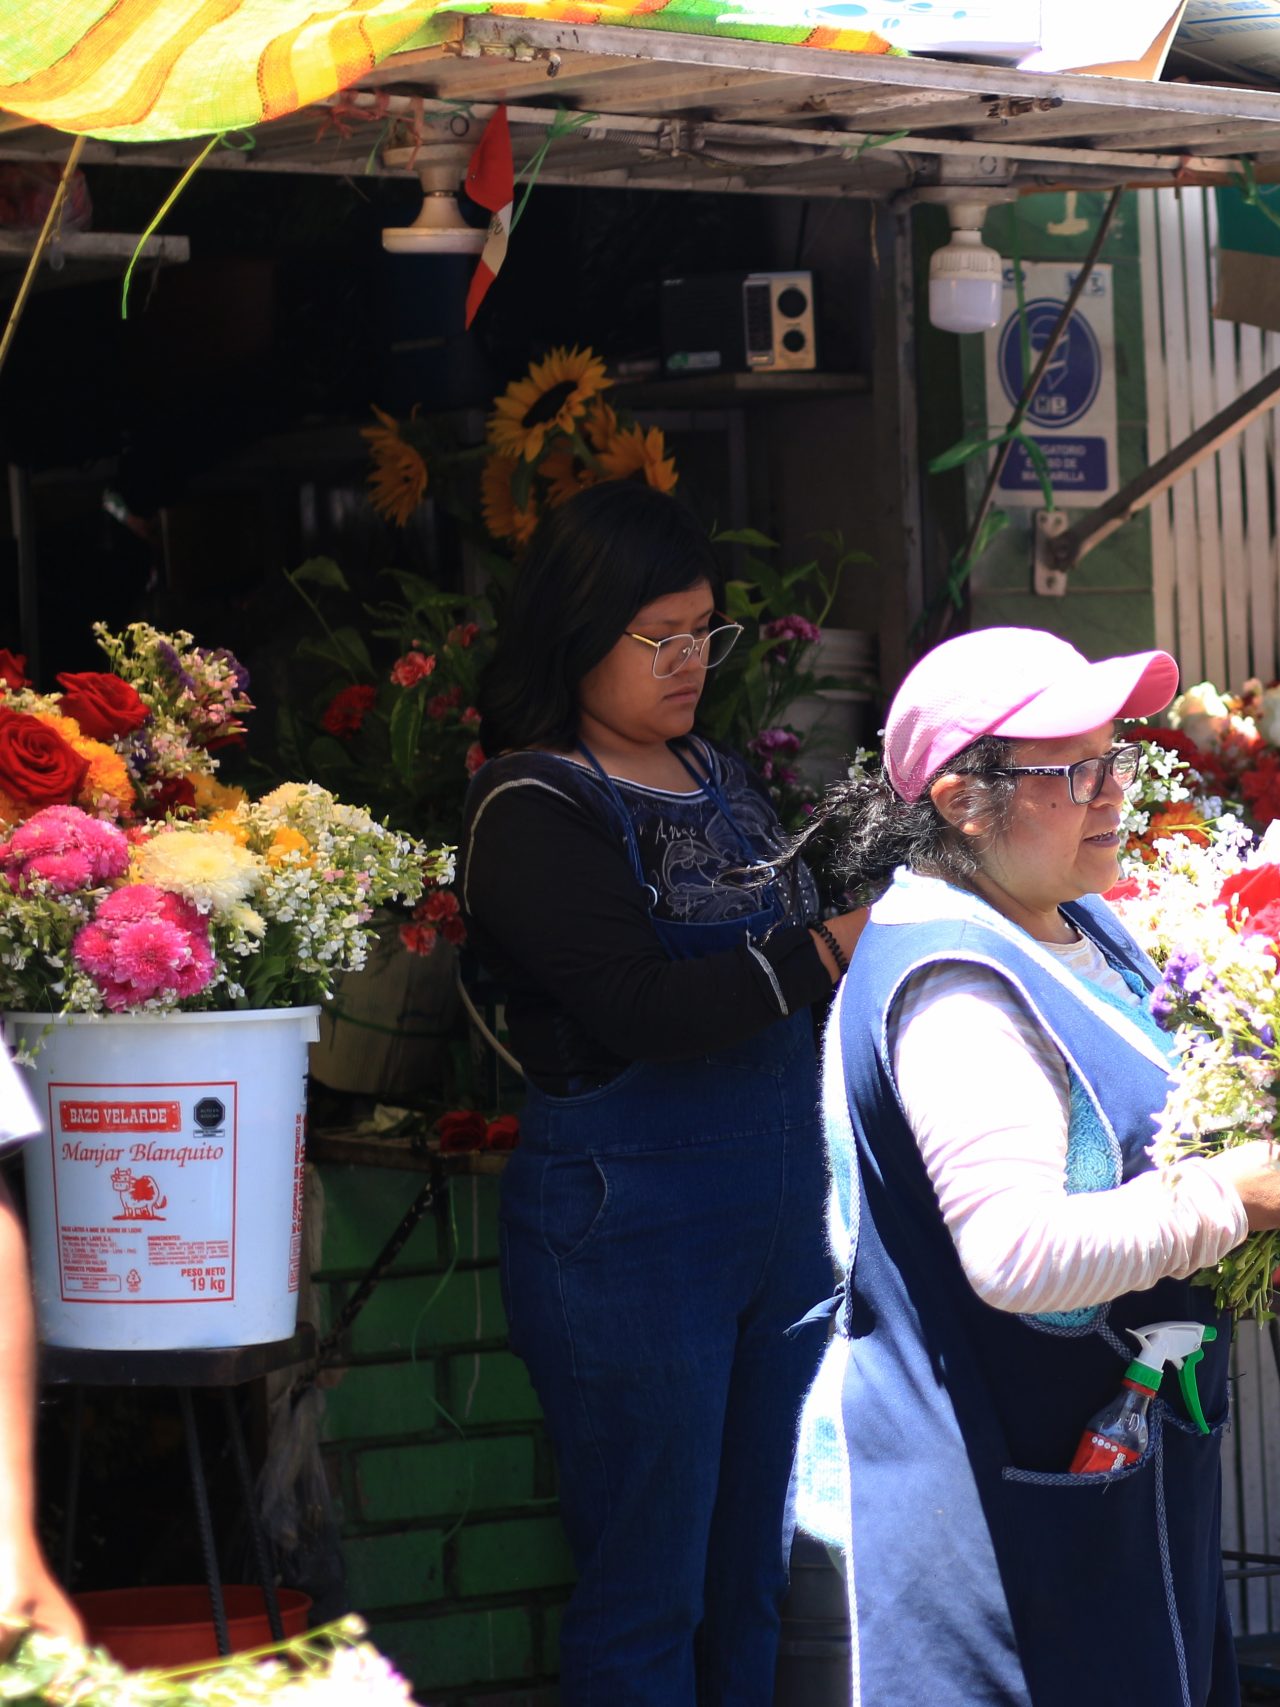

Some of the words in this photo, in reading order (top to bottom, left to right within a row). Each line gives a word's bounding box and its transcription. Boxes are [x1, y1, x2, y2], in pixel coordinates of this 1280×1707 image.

[69, 1108, 99, 1123] BAZO
[102, 1108, 168, 1124] VELARDE
[62, 1141, 124, 1167] Manjar
[129, 1141, 224, 1167] Blanquito
[181, 1268, 203, 1277] PESO
[205, 1267, 226, 1276] NETO
[191, 1277, 205, 1291] 19
[210, 1277, 225, 1293] kg
